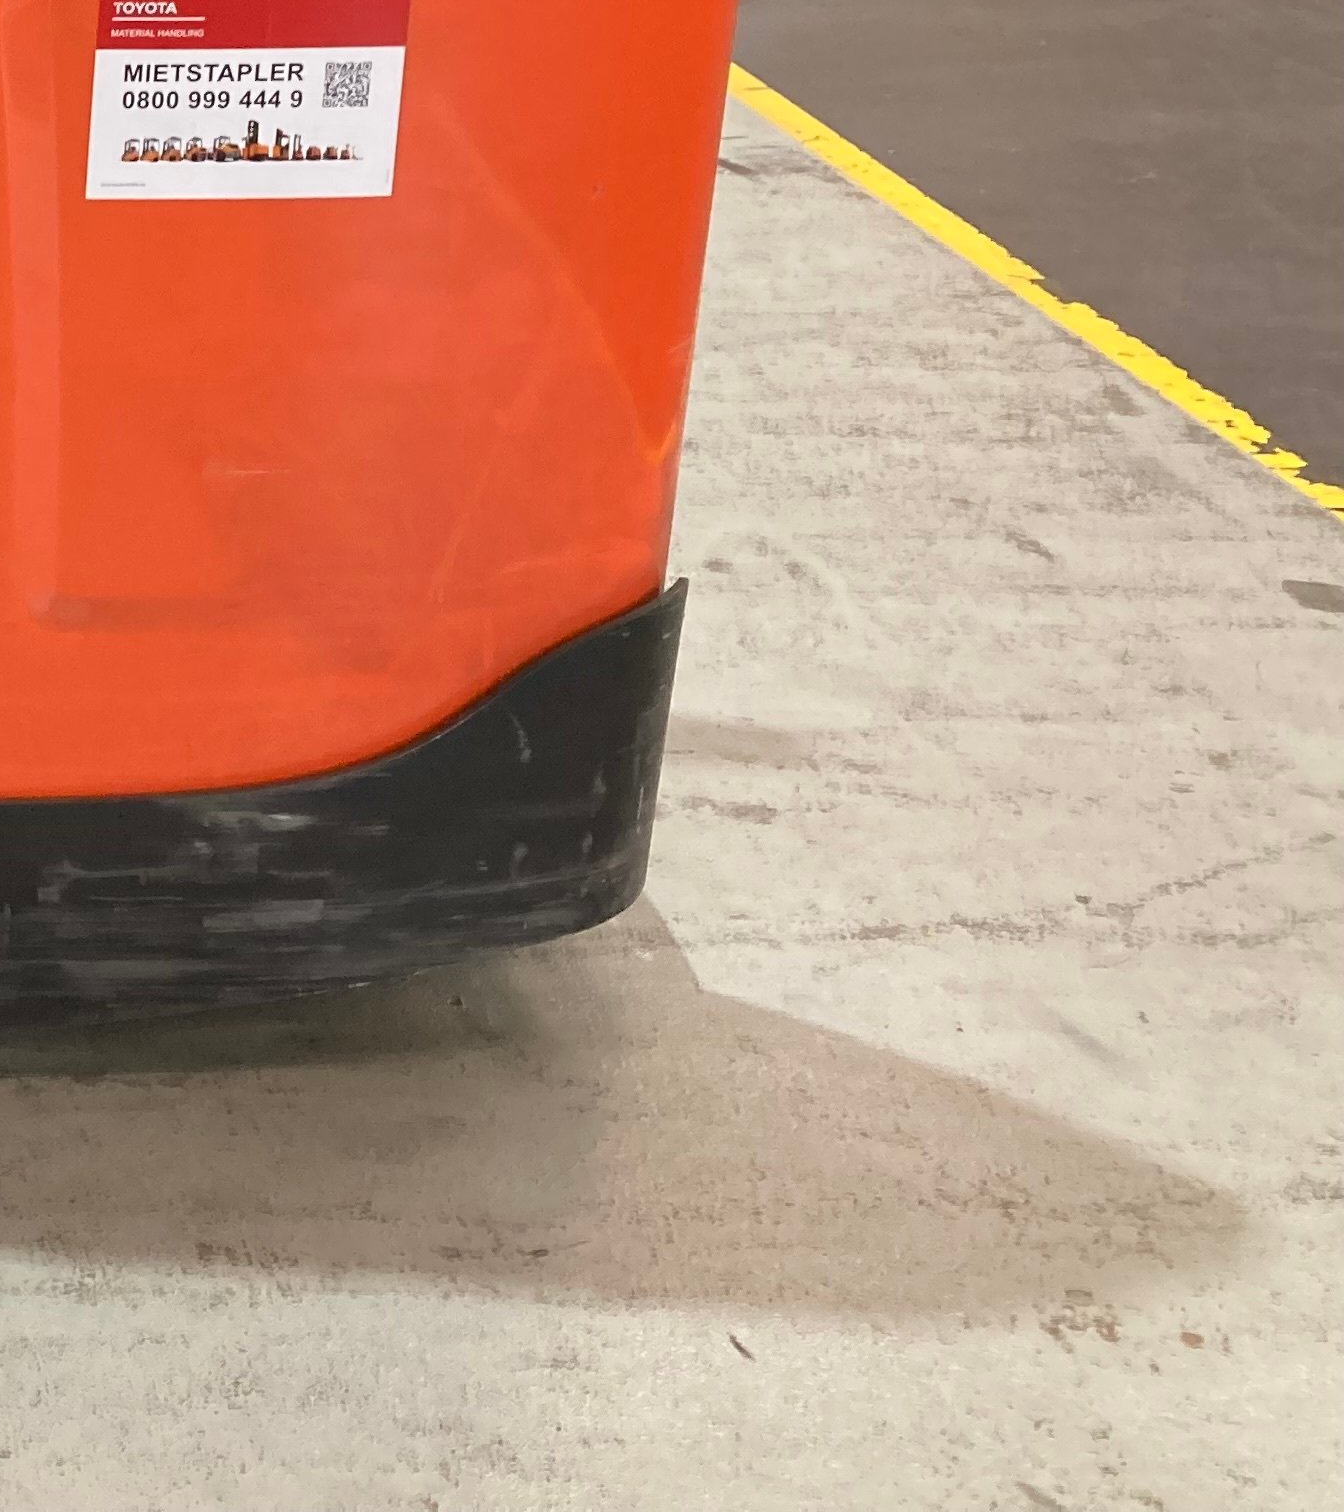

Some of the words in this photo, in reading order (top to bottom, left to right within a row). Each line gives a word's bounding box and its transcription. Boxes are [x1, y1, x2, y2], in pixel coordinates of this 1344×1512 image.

[113, 1, 178, 15] TOYOTA
[110, 29, 155, 38] MATERIAL
[157, 29, 205, 38] HANDLING
[123, 62, 304, 83] MIETSTAPLER
[122, 90, 179, 109] 0800
[188, 90, 230, 109] 999
[238, 90, 281, 109] 444
[290, 89, 304, 109] 9
